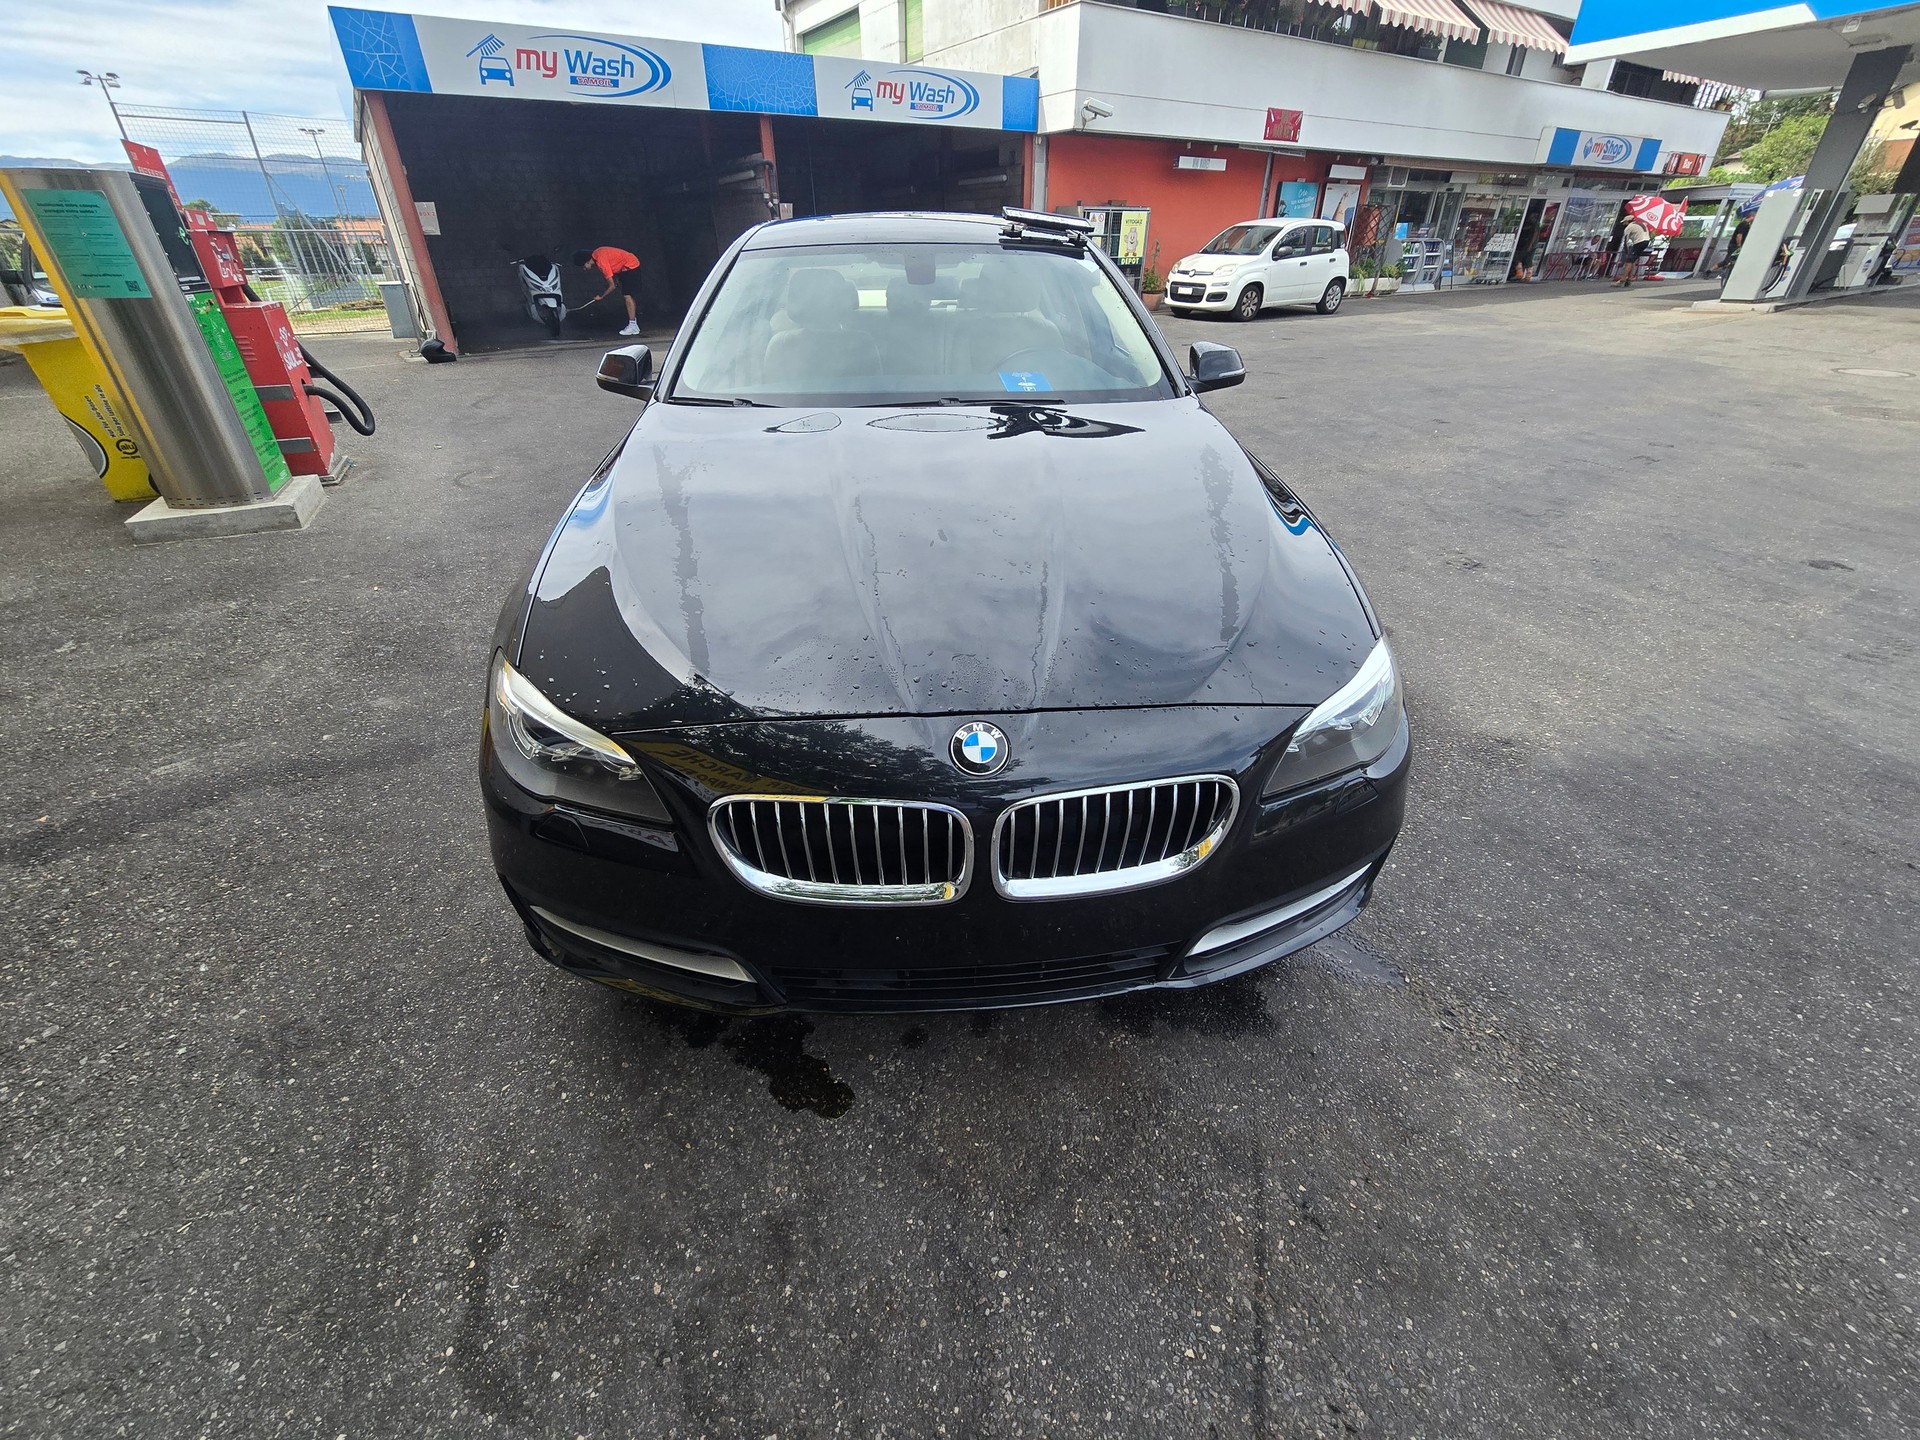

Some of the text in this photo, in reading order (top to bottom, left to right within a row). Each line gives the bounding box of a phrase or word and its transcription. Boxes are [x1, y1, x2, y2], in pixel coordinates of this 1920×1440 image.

[516, 48, 635, 78] my Wash
[576, 77, 613, 87] TAMOIL
[876, 80, 956, 105] my Wash
[956, 723, 1003, 741] BMW
